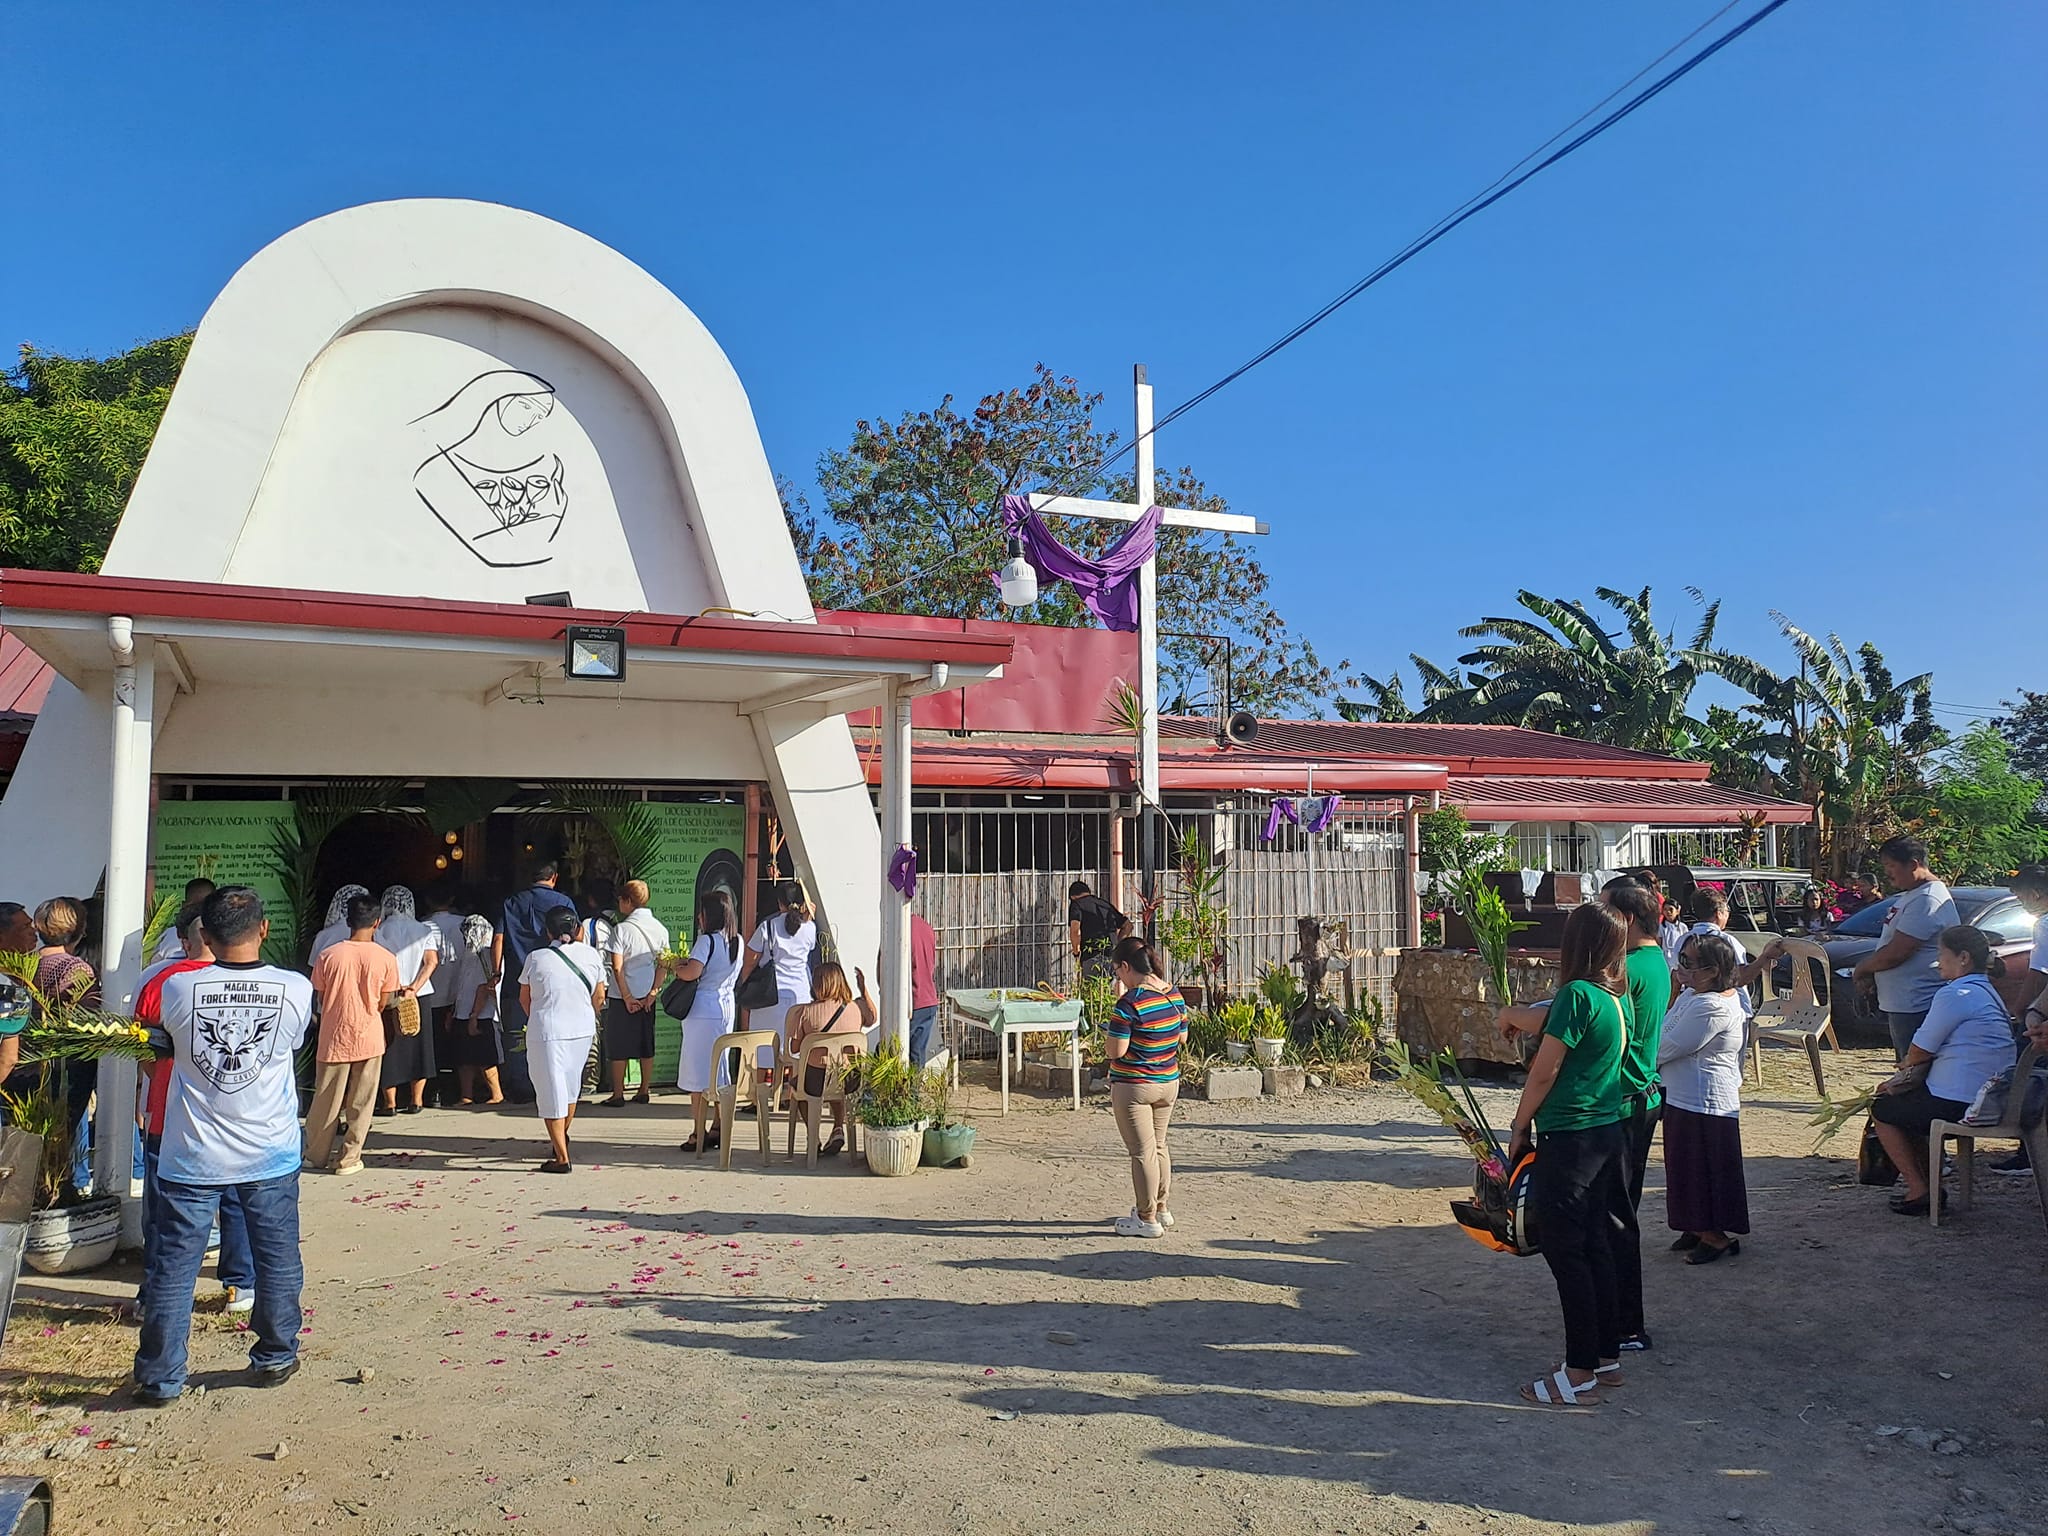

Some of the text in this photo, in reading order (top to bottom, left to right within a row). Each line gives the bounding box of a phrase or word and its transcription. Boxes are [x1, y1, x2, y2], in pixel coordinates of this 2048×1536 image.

[224, 983, 260, 992] MAGILAS
[201, 994, 279, 1005] FORCE MULTIPLIER
